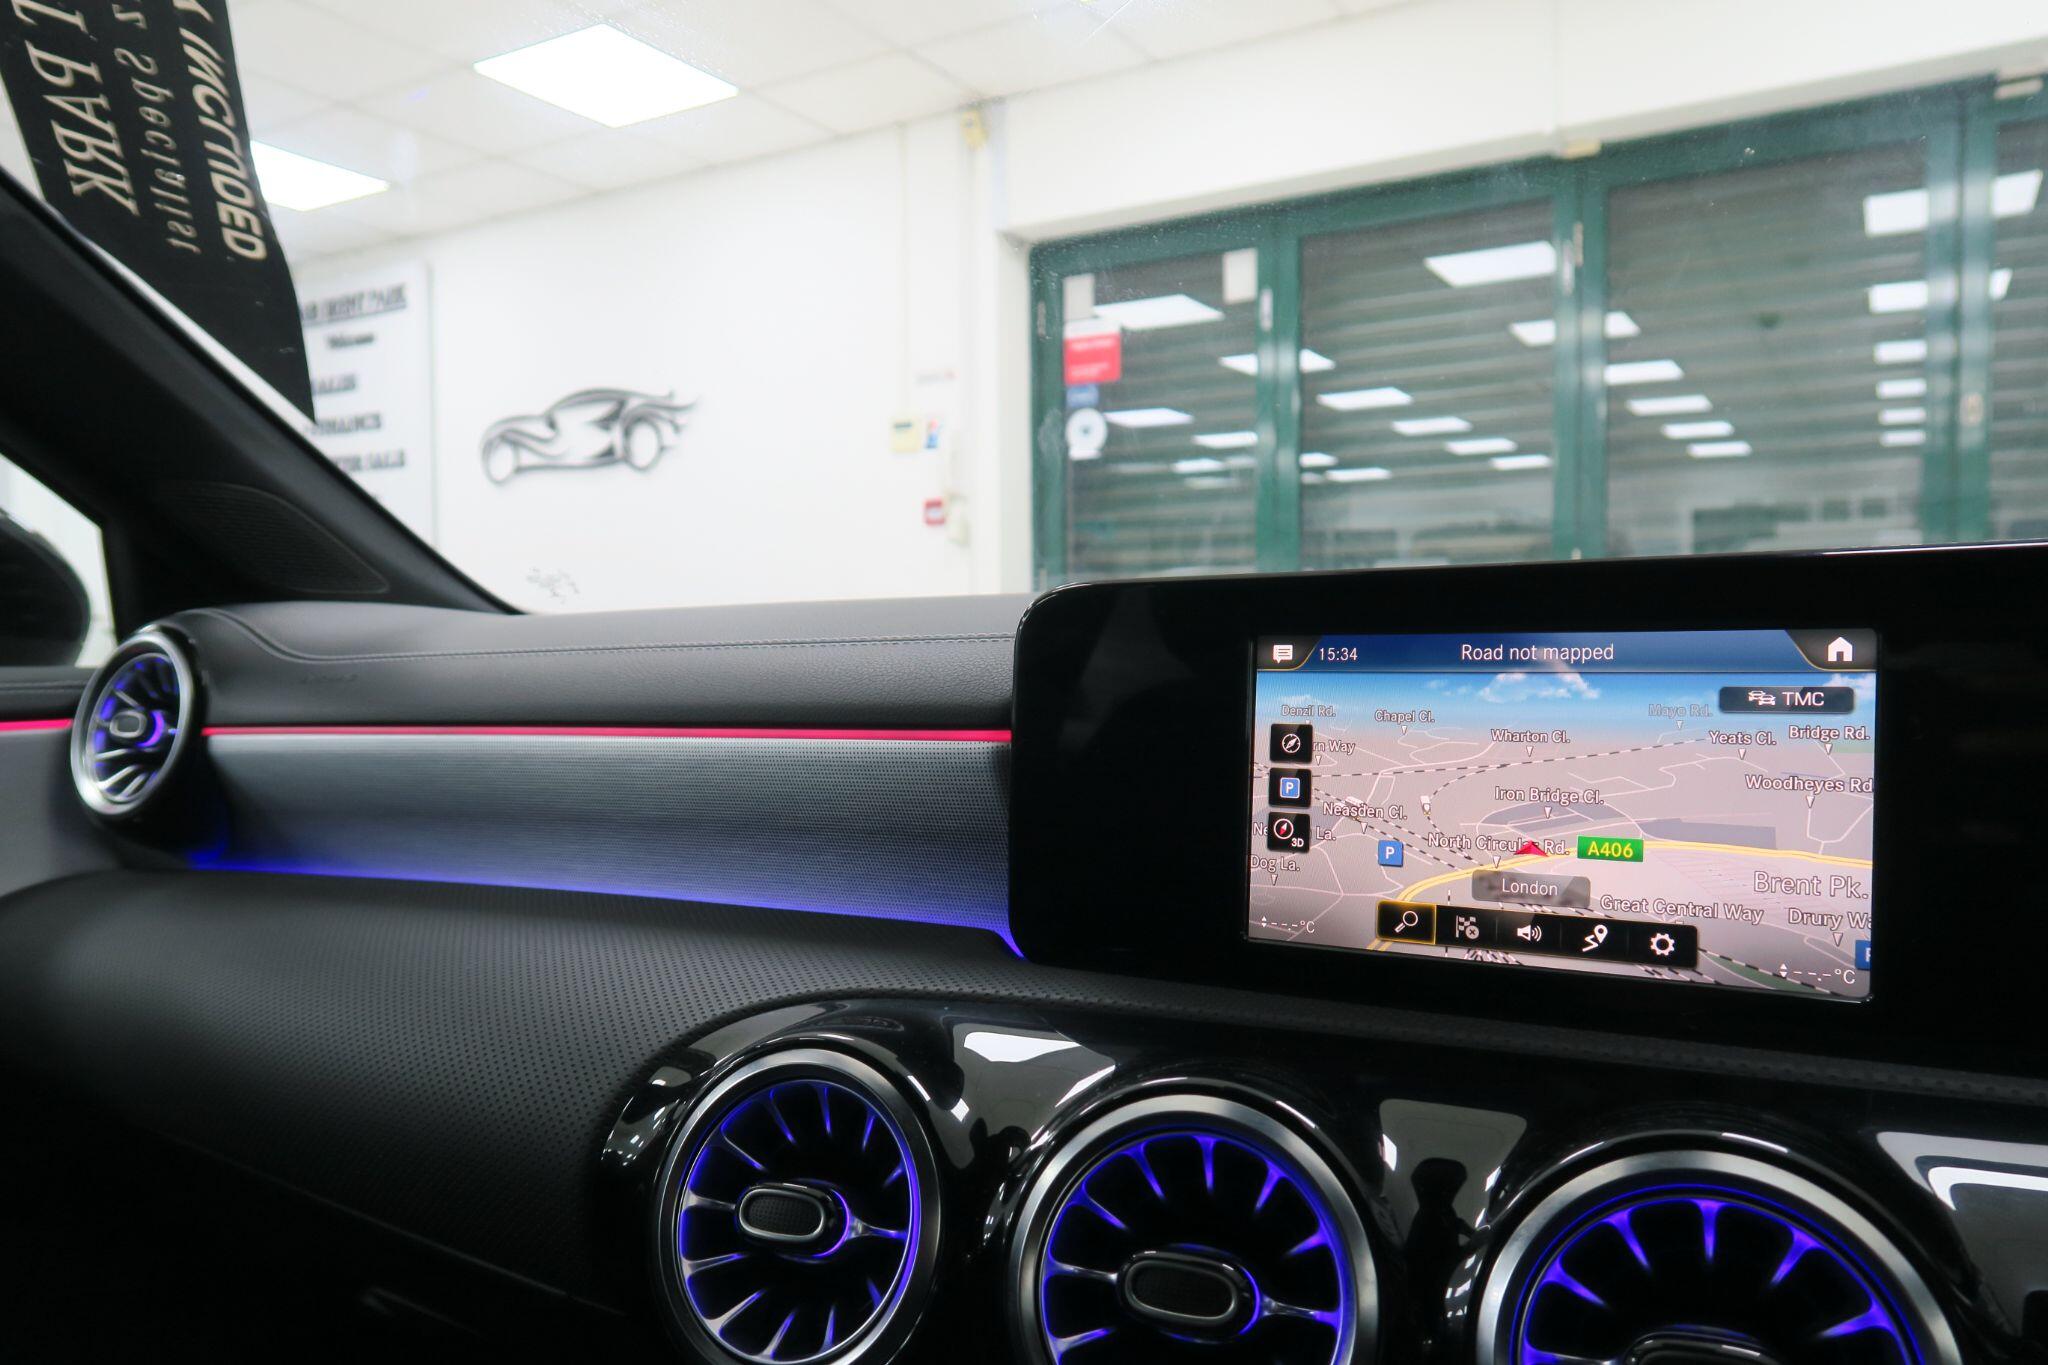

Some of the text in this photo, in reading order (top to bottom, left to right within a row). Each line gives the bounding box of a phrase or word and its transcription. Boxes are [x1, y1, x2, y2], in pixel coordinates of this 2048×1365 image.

[1318, 647, 1358, 662] 15:34
[1461, 642, 1615, 664] Road not mapped
[1782, 691, 1825, 706] TMC
[1281, 704, 1337, 718] Denzil Rd.
[1374, 709, 1436, 725] Chapel Cl.
[1648, 703, 1714, 719] Mayo Rd.
[1491, 728, 1571, 744] Wharton Cl.
[1708, 731, 1777, 746] Yeats Cl.
[1788, 725, 1871, 744] Bridge Rd.
[1328, 739, 1356, 755] Way
[1745, 773, 1845, 796] Woodheyes
[1494, 785, 1605, 806] Iron Bridge Cl.
[1322, 801, 1408, 821] Neasden Cl.
[1315, 825, 1337, 841] La.
[1291, 837, 1305, 848] 3D
[1427, 831, 1472, 850] North
[1544, 839, 1571, 856] Rd.
[1587, 840, 1634, 858] A406
[1250, 854, 1301, 873] Dog La.
[1502, 878, 1558, 896] London
[1753, 870, 1869, 900] Brent Pk.
[1600, 894, 1765, 926] Great Central Way
[1788, 906, 1844, 932] Drury
